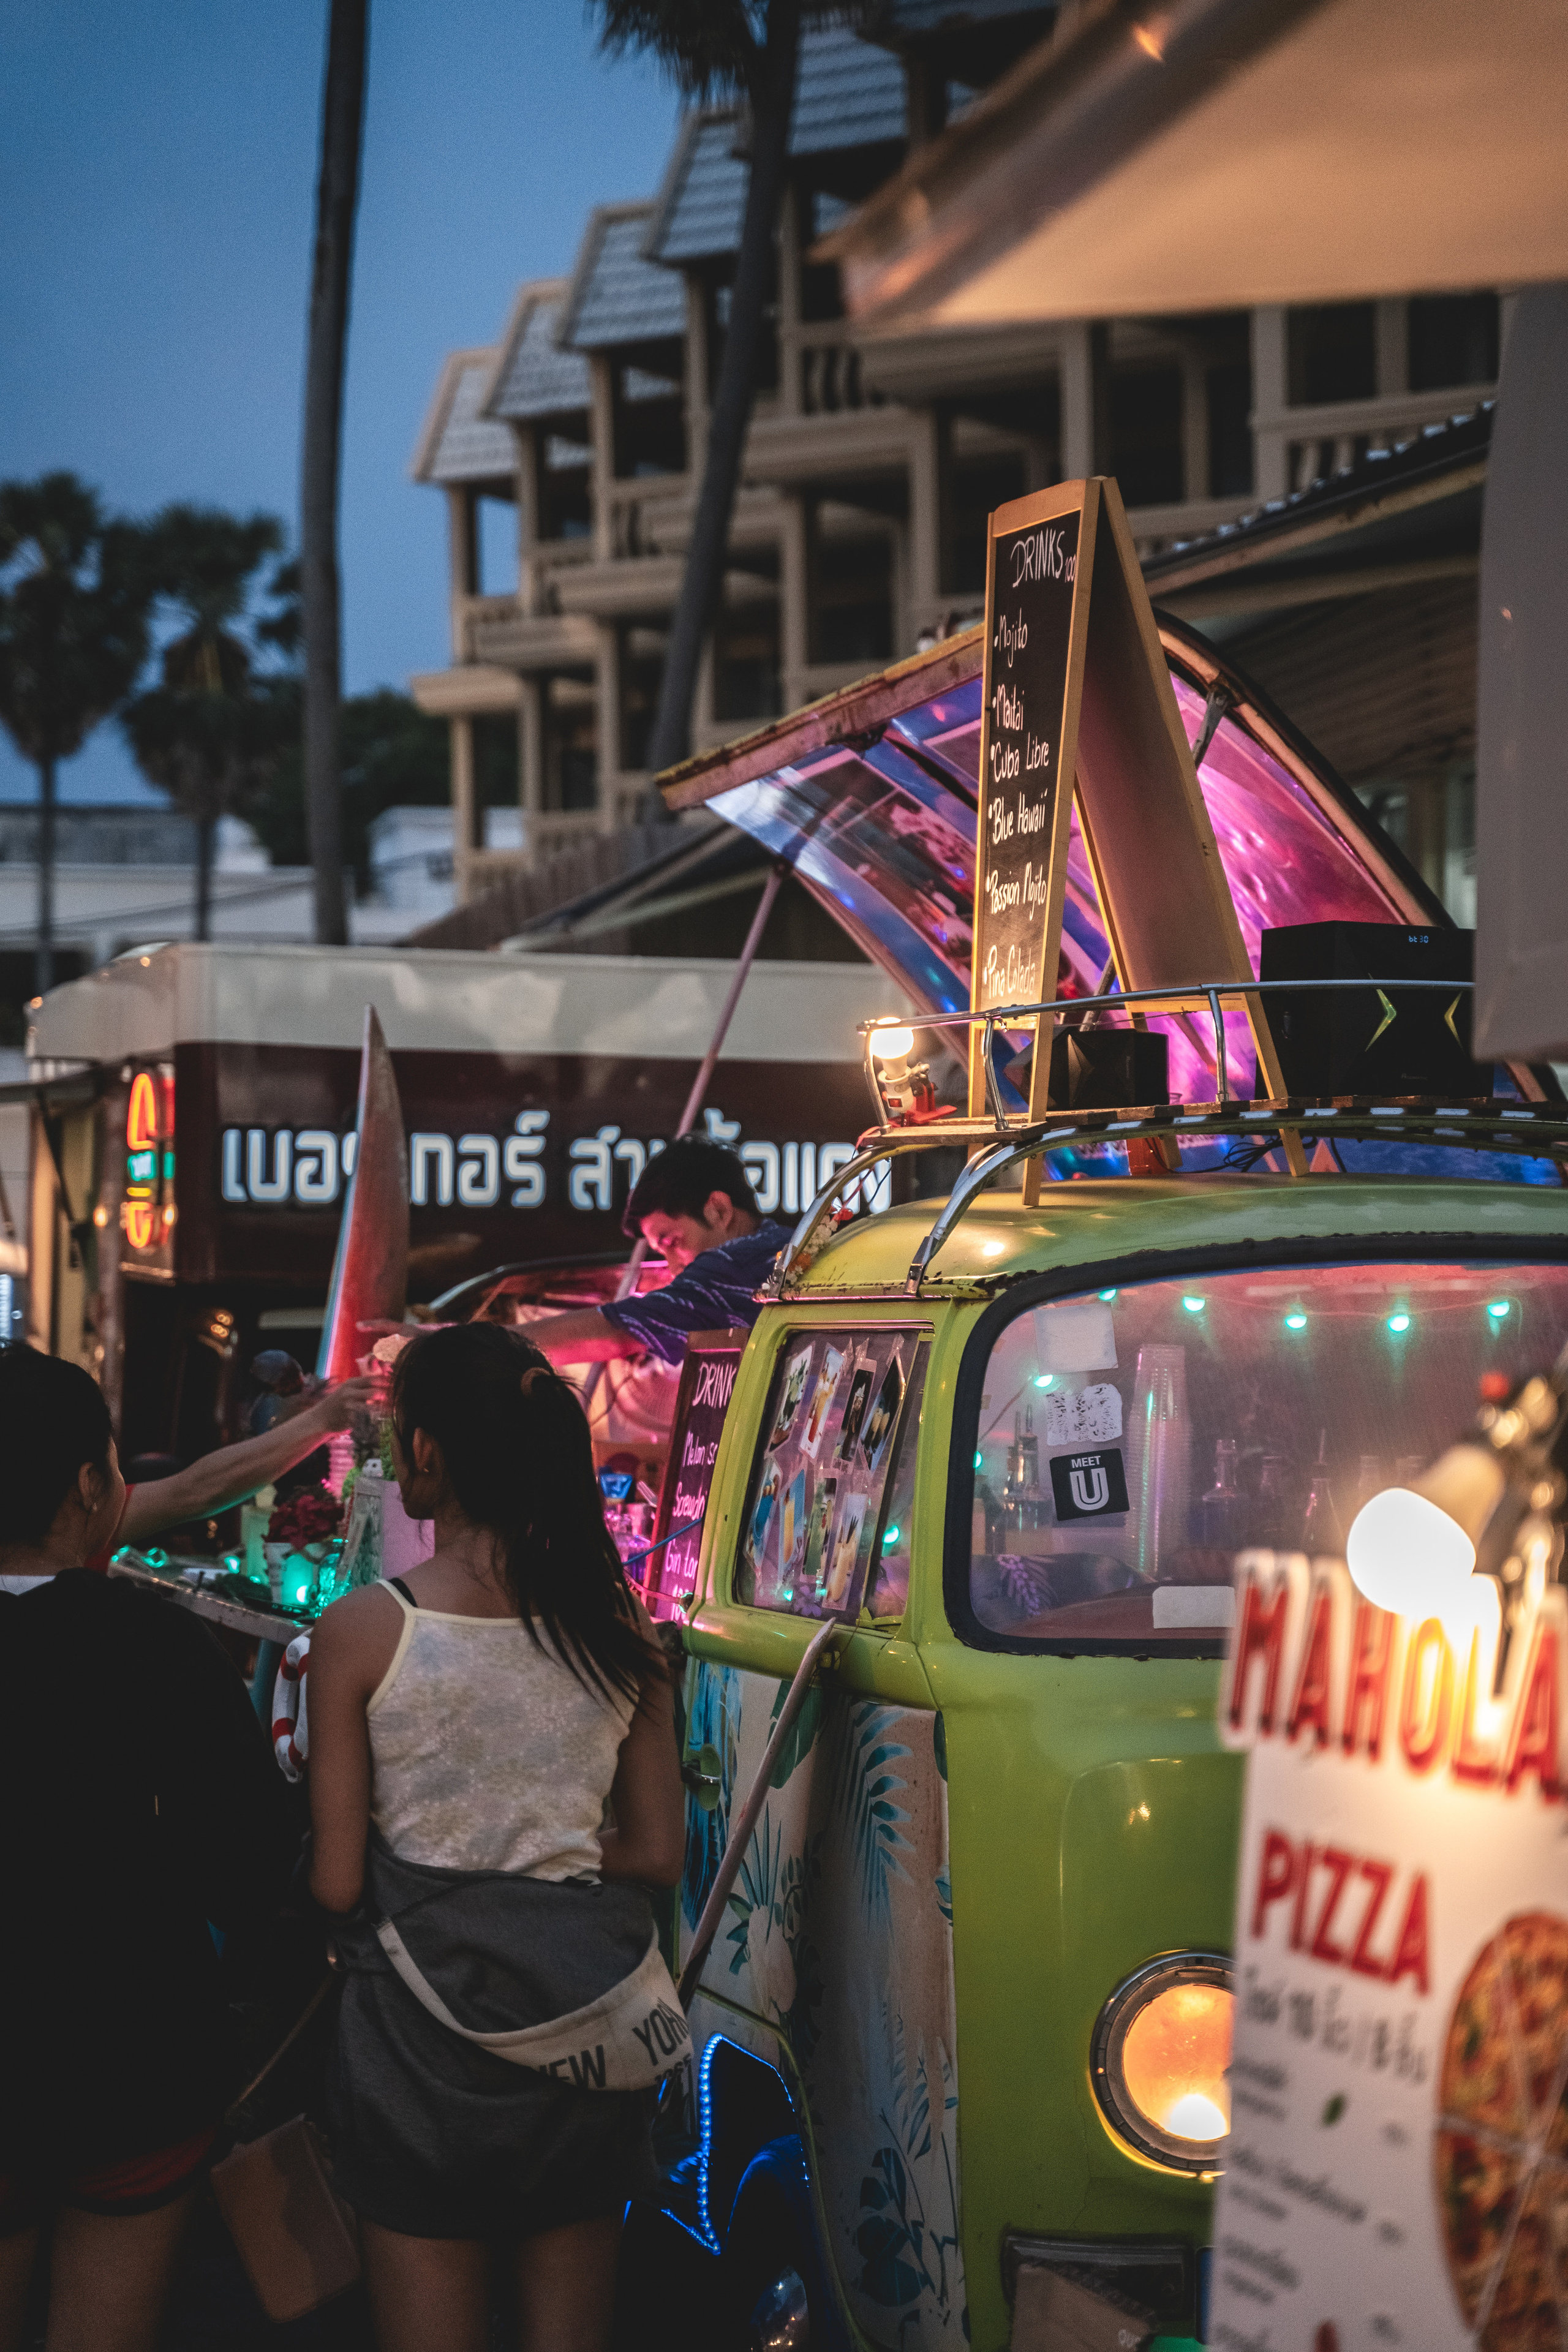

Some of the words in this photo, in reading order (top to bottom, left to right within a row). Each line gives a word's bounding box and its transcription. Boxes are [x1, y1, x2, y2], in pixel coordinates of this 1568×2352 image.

[1010, 527, 1065, 587] DRINKS
[1065, 553, 1077, 583] 100
[999, 607, 1028, 668] Mojito
[993, 741, 1020, 783] Cuba
[1025, 731, 1049, 770] Libre
[992, 796, 1014, 845] Blue
[1017, 788, 1048, 834] Hawaii
[990, 869, 1020, 914] Passion
[1023, 861, 1047, 921] Mojito
[1008, 944, 1036, 996] Colada
[692, 1361, 737, 1409] DRINK
[1071, 1455, 1101, 1468] MEET
[1069, 1468, 1109, 1511] U
[1250, 1828, 1431, 1998] PIZZA
[540, 2044, 606, 2089] EW
